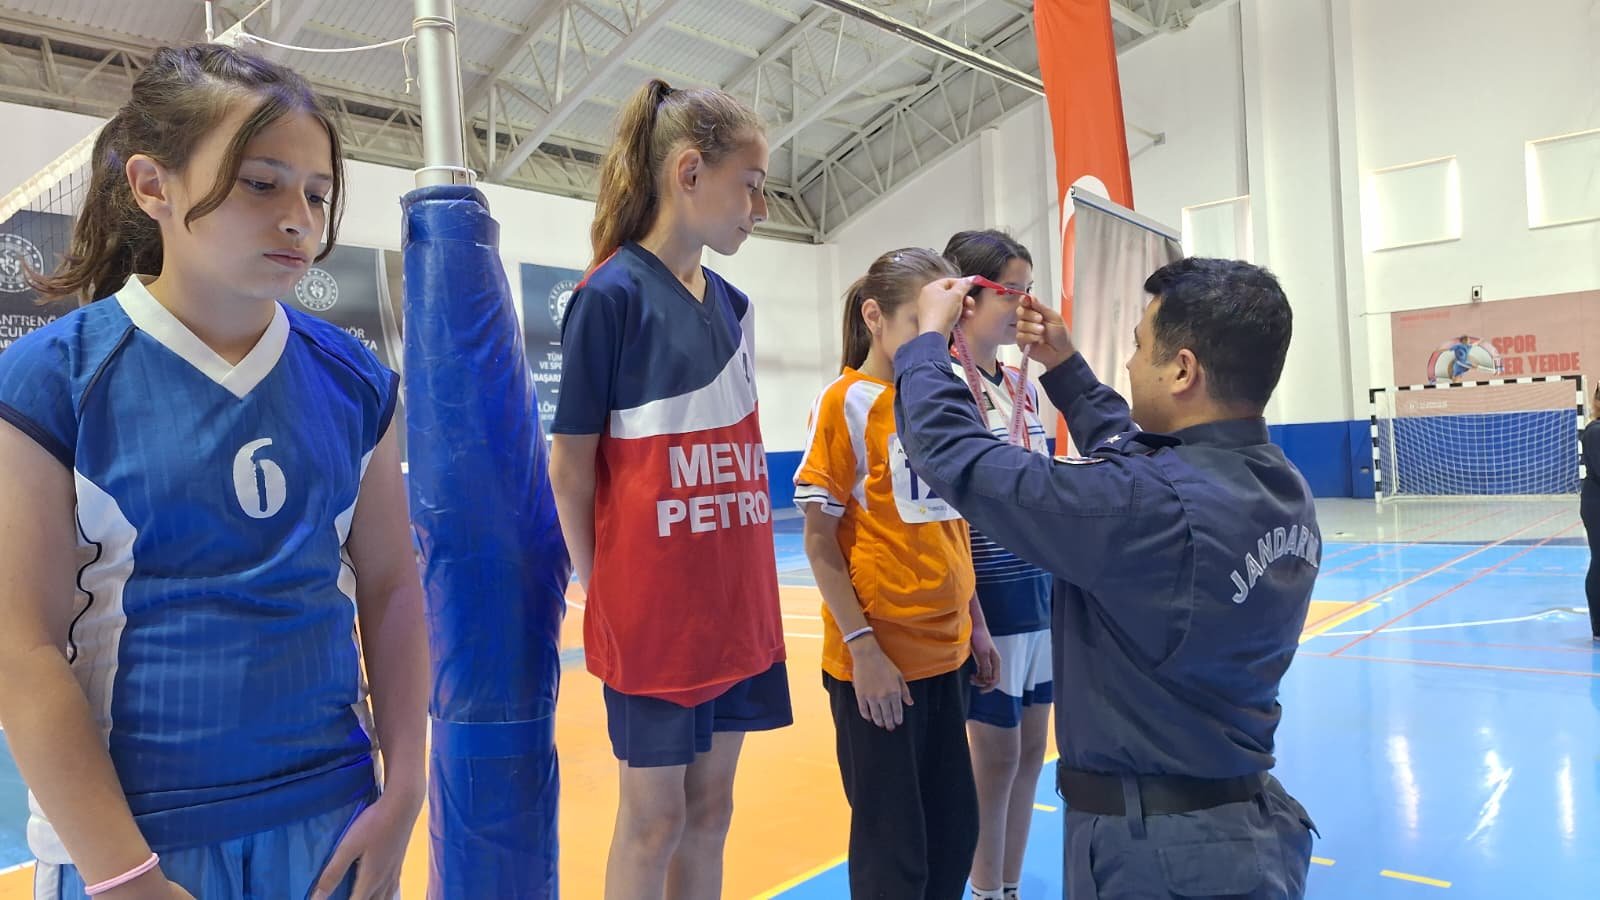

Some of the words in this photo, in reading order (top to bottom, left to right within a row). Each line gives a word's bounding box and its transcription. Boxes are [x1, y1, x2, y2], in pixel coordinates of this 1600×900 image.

[1492, 334, 1537, 355] SPOR
[1497, 357, 1524, 376] ER
[1528, 352, 1581, 374] YERDE
[233, 437, 287, 519] 6
[668, 442, 769, 489] MEVA
[656, 490, 770, 537] PETRO
